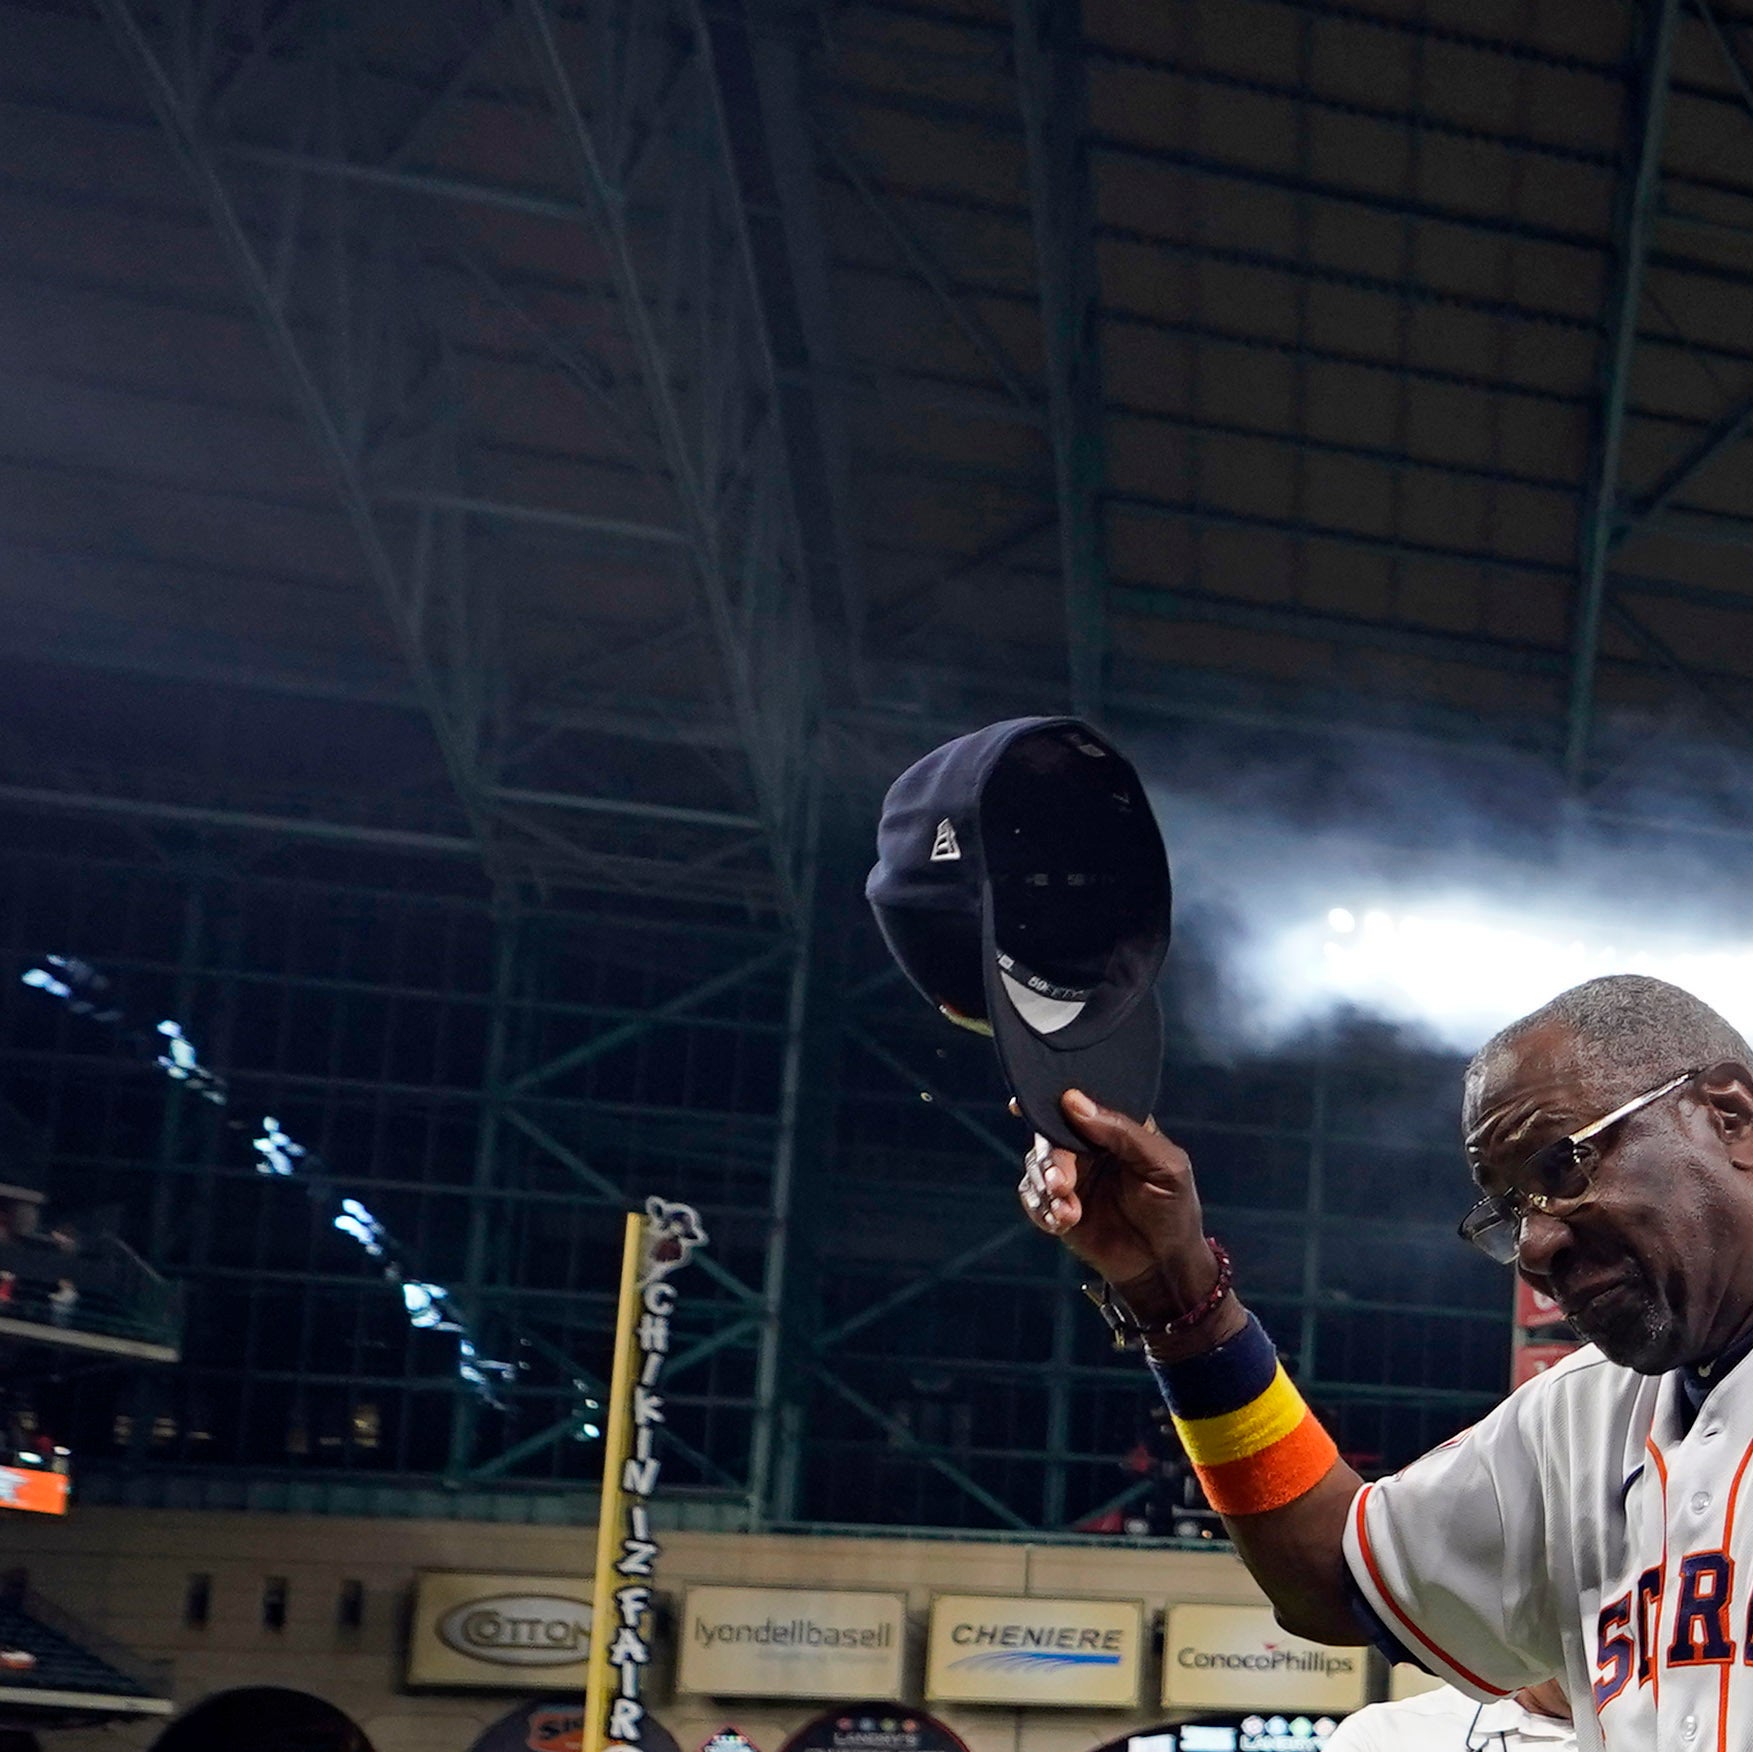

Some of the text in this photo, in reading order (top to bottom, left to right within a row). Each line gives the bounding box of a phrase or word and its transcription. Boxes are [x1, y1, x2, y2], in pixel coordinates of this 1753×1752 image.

[694, 1616, 892, 1650] lyondellbasell
[950, 1621, 1125, 1652] CHENIERE
[609, 1587, 650, 1742] FAIR
[1177, 1643, 1356, 1677] ConocoPhillips
